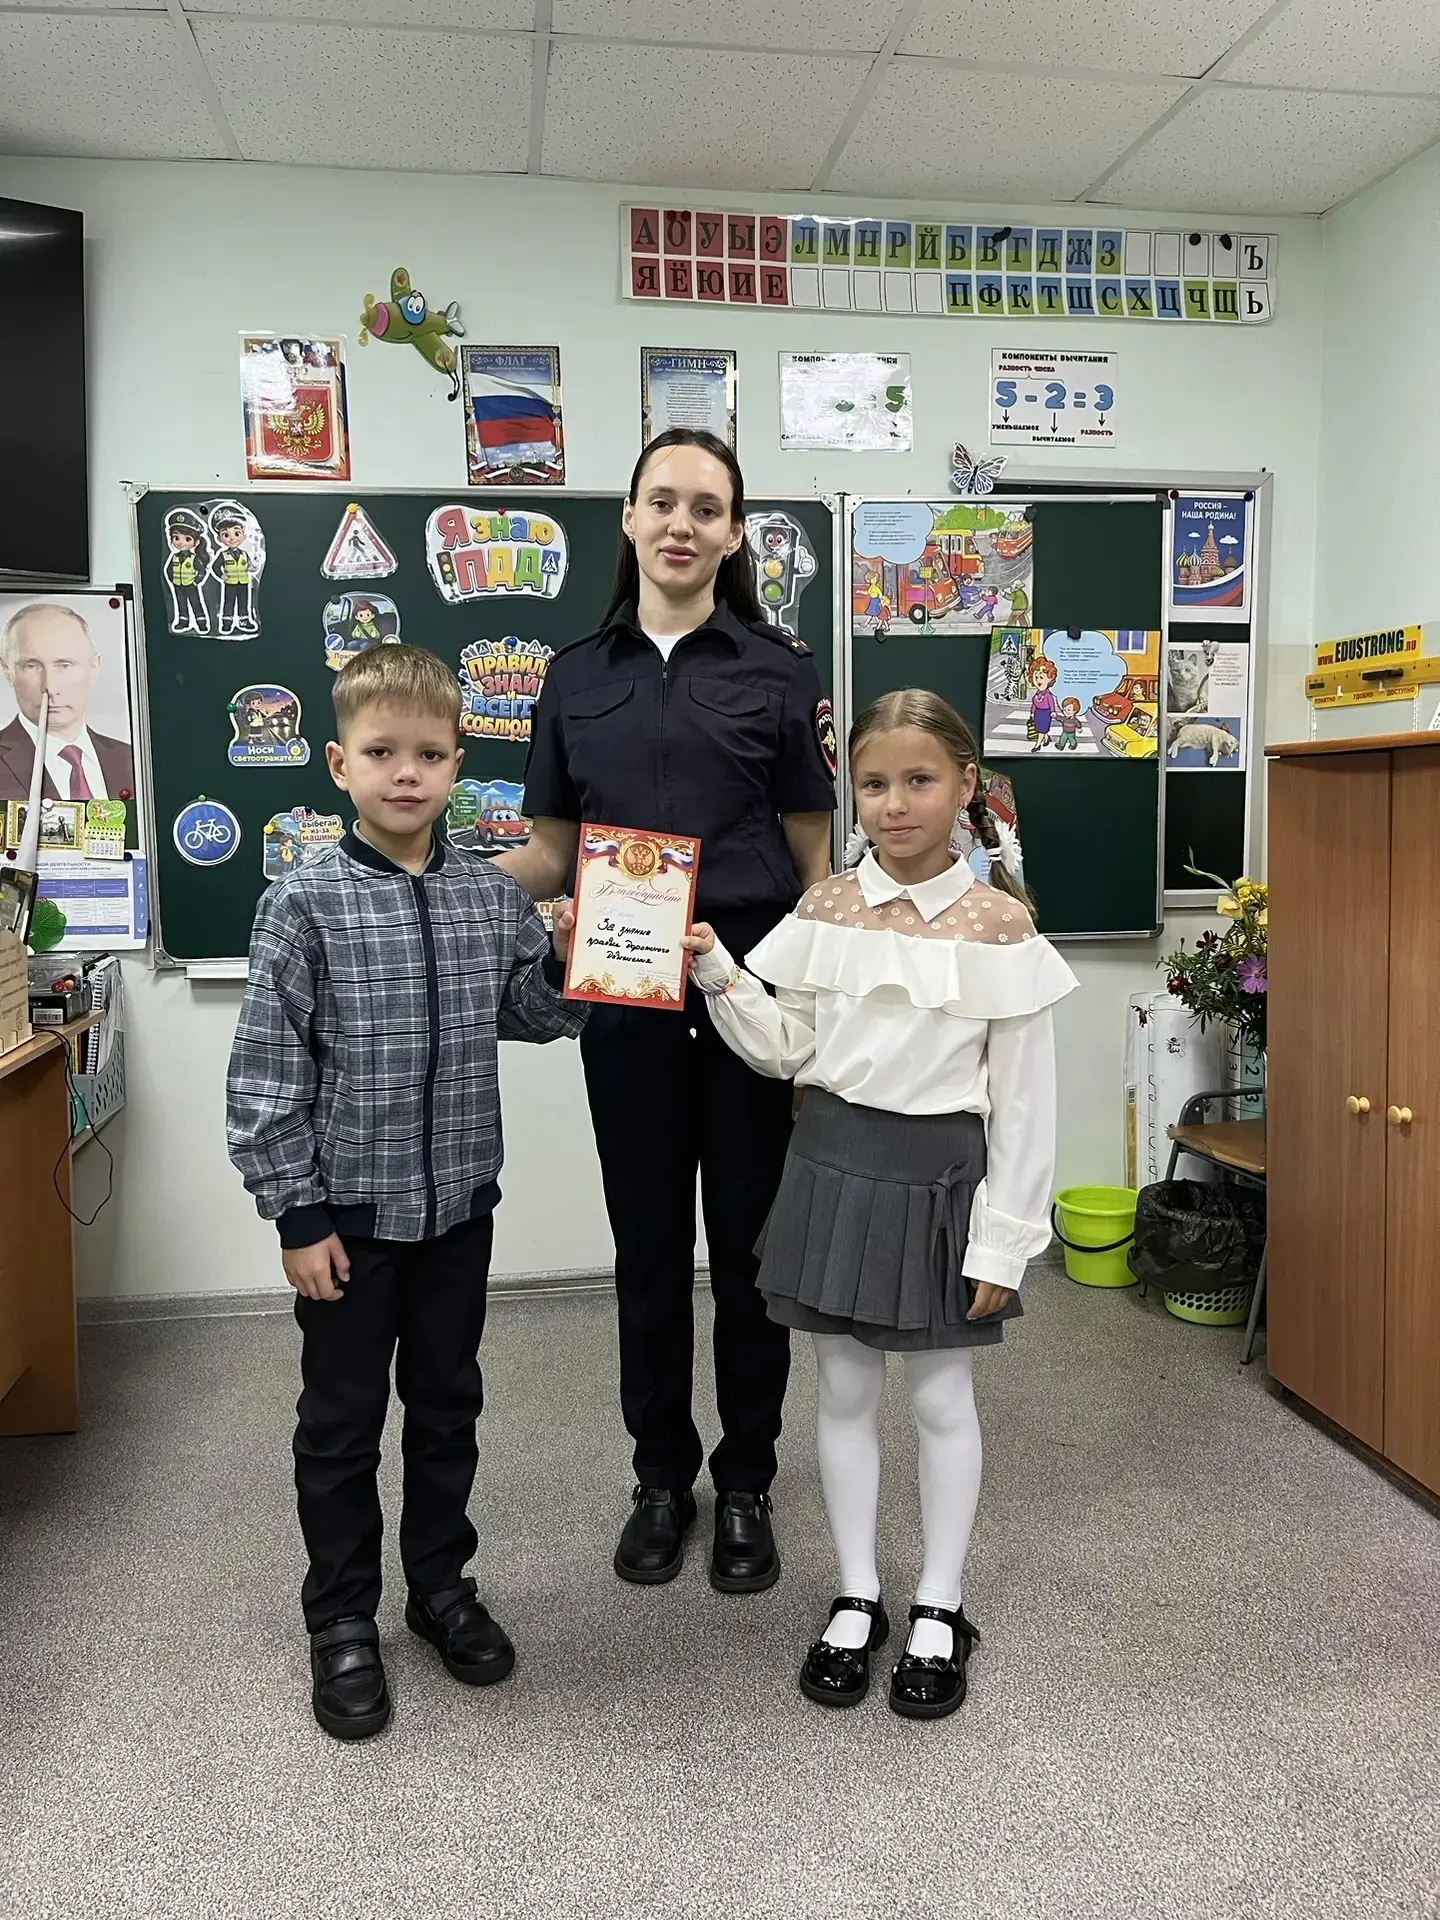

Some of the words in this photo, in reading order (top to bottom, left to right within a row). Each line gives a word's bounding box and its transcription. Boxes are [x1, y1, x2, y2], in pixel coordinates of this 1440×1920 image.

[495, 356, 527, 366] ФЛАГ
[671, 358, 707, 369] ГИМН
[1002, 353, 1057, 361] КОМПОНЕНТЫ
[1060, 354, 1109, 363] ВЫЧИТАНИЯ
[995, 381, 1018, 408] 5
[1045, 382, 1067, 409] 2
[1093, 384, 1114, 411] 3
[1080, 429, 1114, 437] РАЗНОСТЬ
[1194, 502, 1222, 510] РОССИЯ
[1182, 510, 1204, 519] НАША
[1205, 511, 1237, 520] РОДИНА!
[437, 507, 470, 549] Я
[471, 514, 555, 545] знаю
[454, 547, 544, 592] ПДД
[467, 655, 548, 680] ПРАВИЛ
[481, 673, 539, 697] ЗНАЙ
[248, 745, 275, 755] Носи
[233, 753, 305, 763] светоотражатели!
[294, 808, 315, 821] Не
[302, 819, 338, 828] выбегай
[590, 880, 682, 905] Благодарность
[597, 918, 616, 931] За
[617, 925, 652, 937] знание
[586, 937, 621, 948] правил
